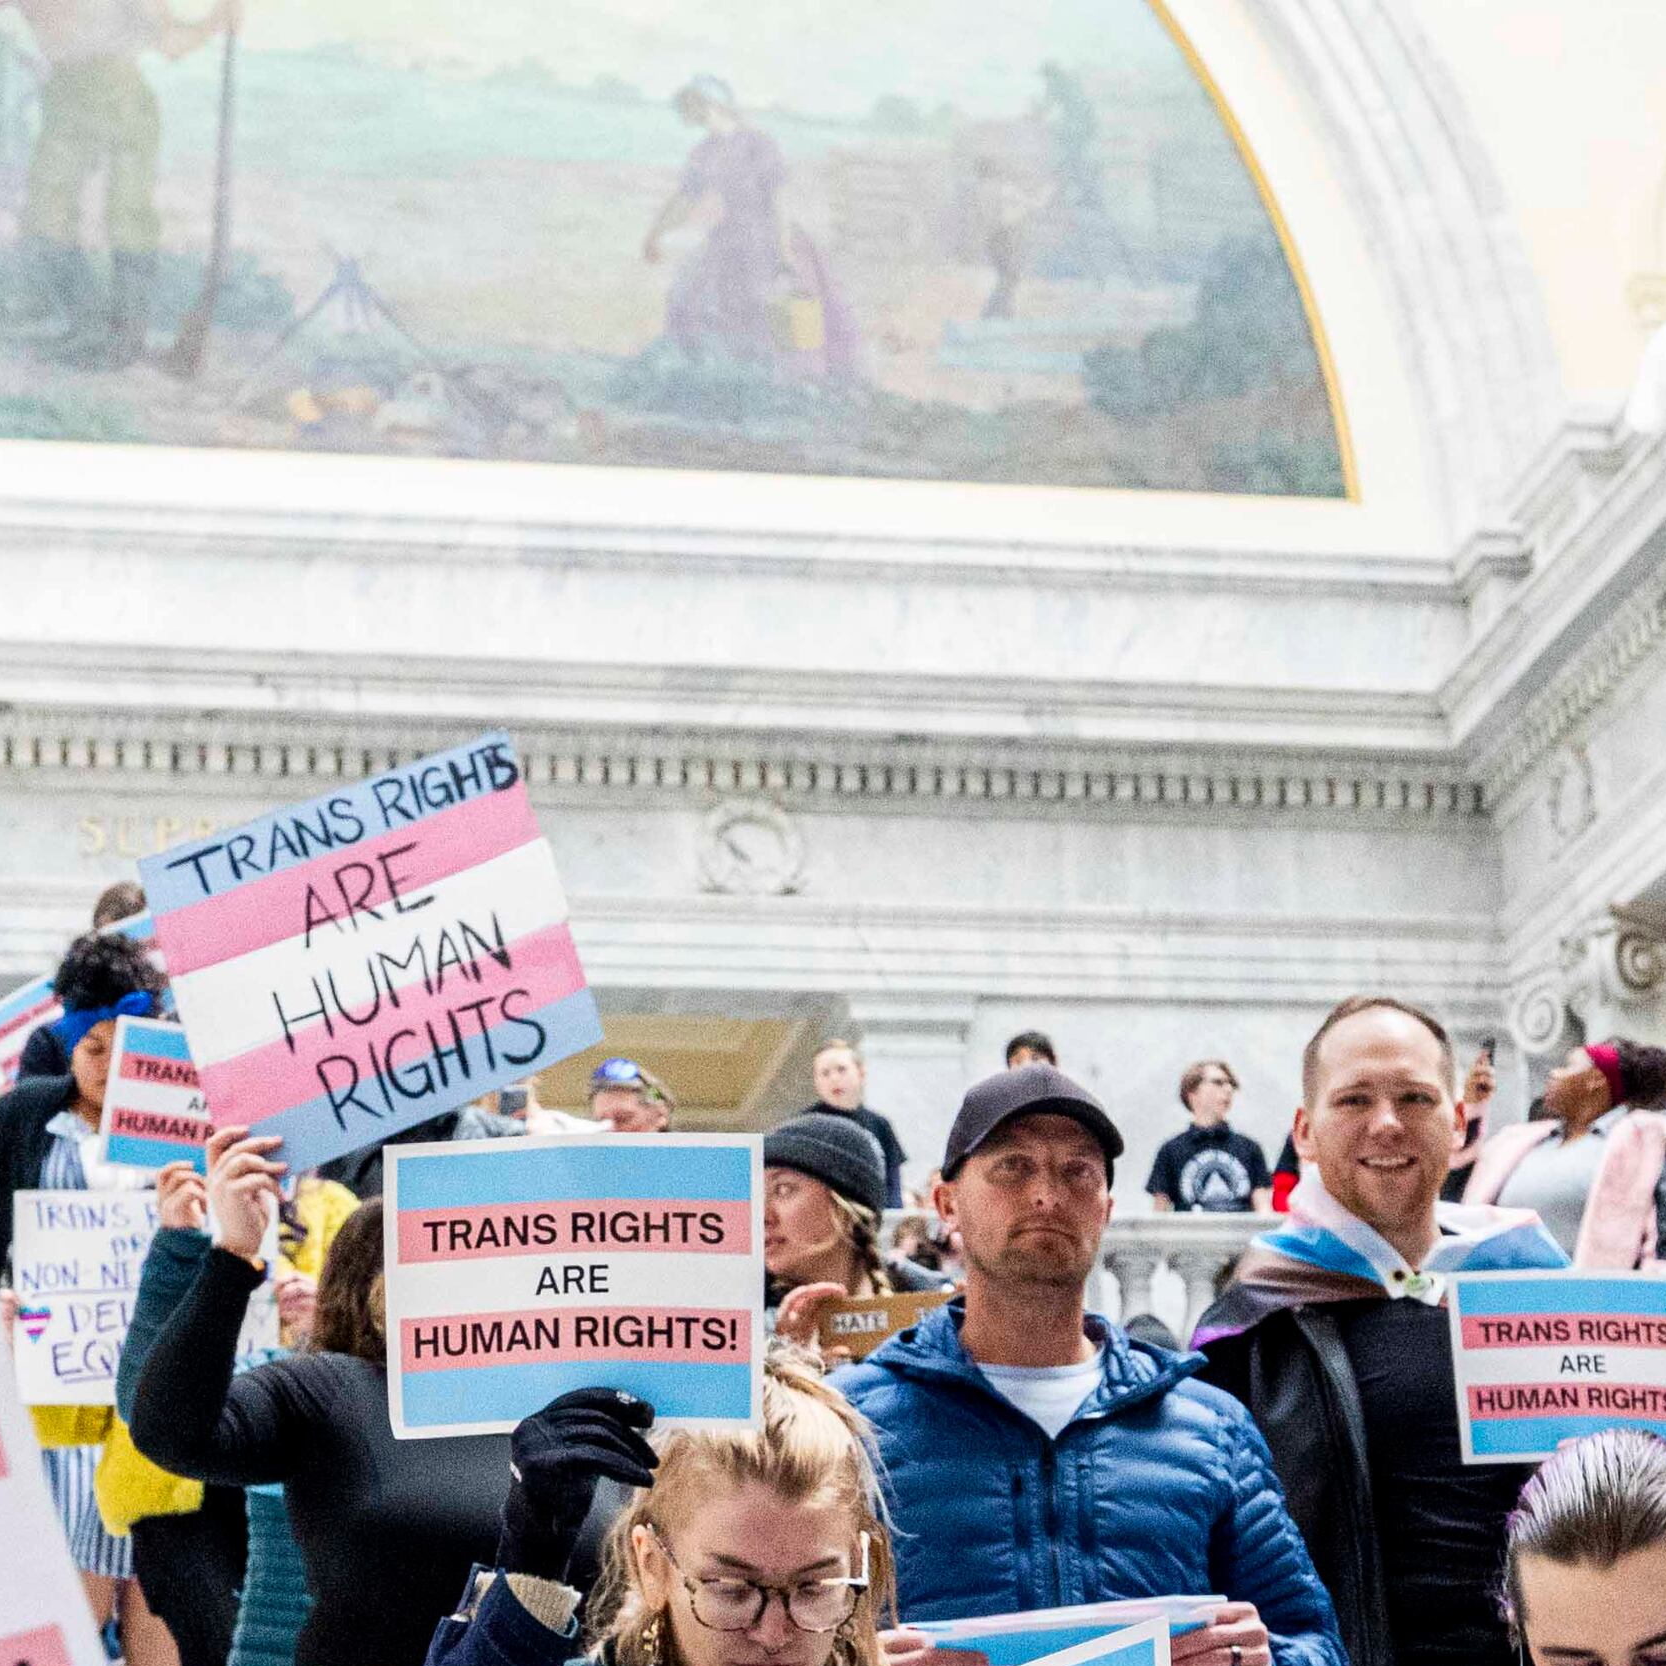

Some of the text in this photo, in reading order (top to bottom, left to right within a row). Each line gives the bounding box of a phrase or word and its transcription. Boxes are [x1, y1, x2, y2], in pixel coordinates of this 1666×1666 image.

[165, 798, 365, 896] TRANS
[302, 841, 435, 948] ARE
[272, 910, 512, 1054] HUMAN
[316, 988, 547, 1130] RIGHTS
[117, 1111, 197, 1139] HUMAN
[423, 1210, 726, 1253] TRANS RIGHTS
[535, 1264, 610, 1296] ARE
[414, 1315, 738, 1358] HUMAN RIGHTS!
[1479, 1319, 1572, 1343] TRANS
[1560, 1354, 1607, 1374] ARE
[1476, 1387, 1580, 1412] HUMAN
